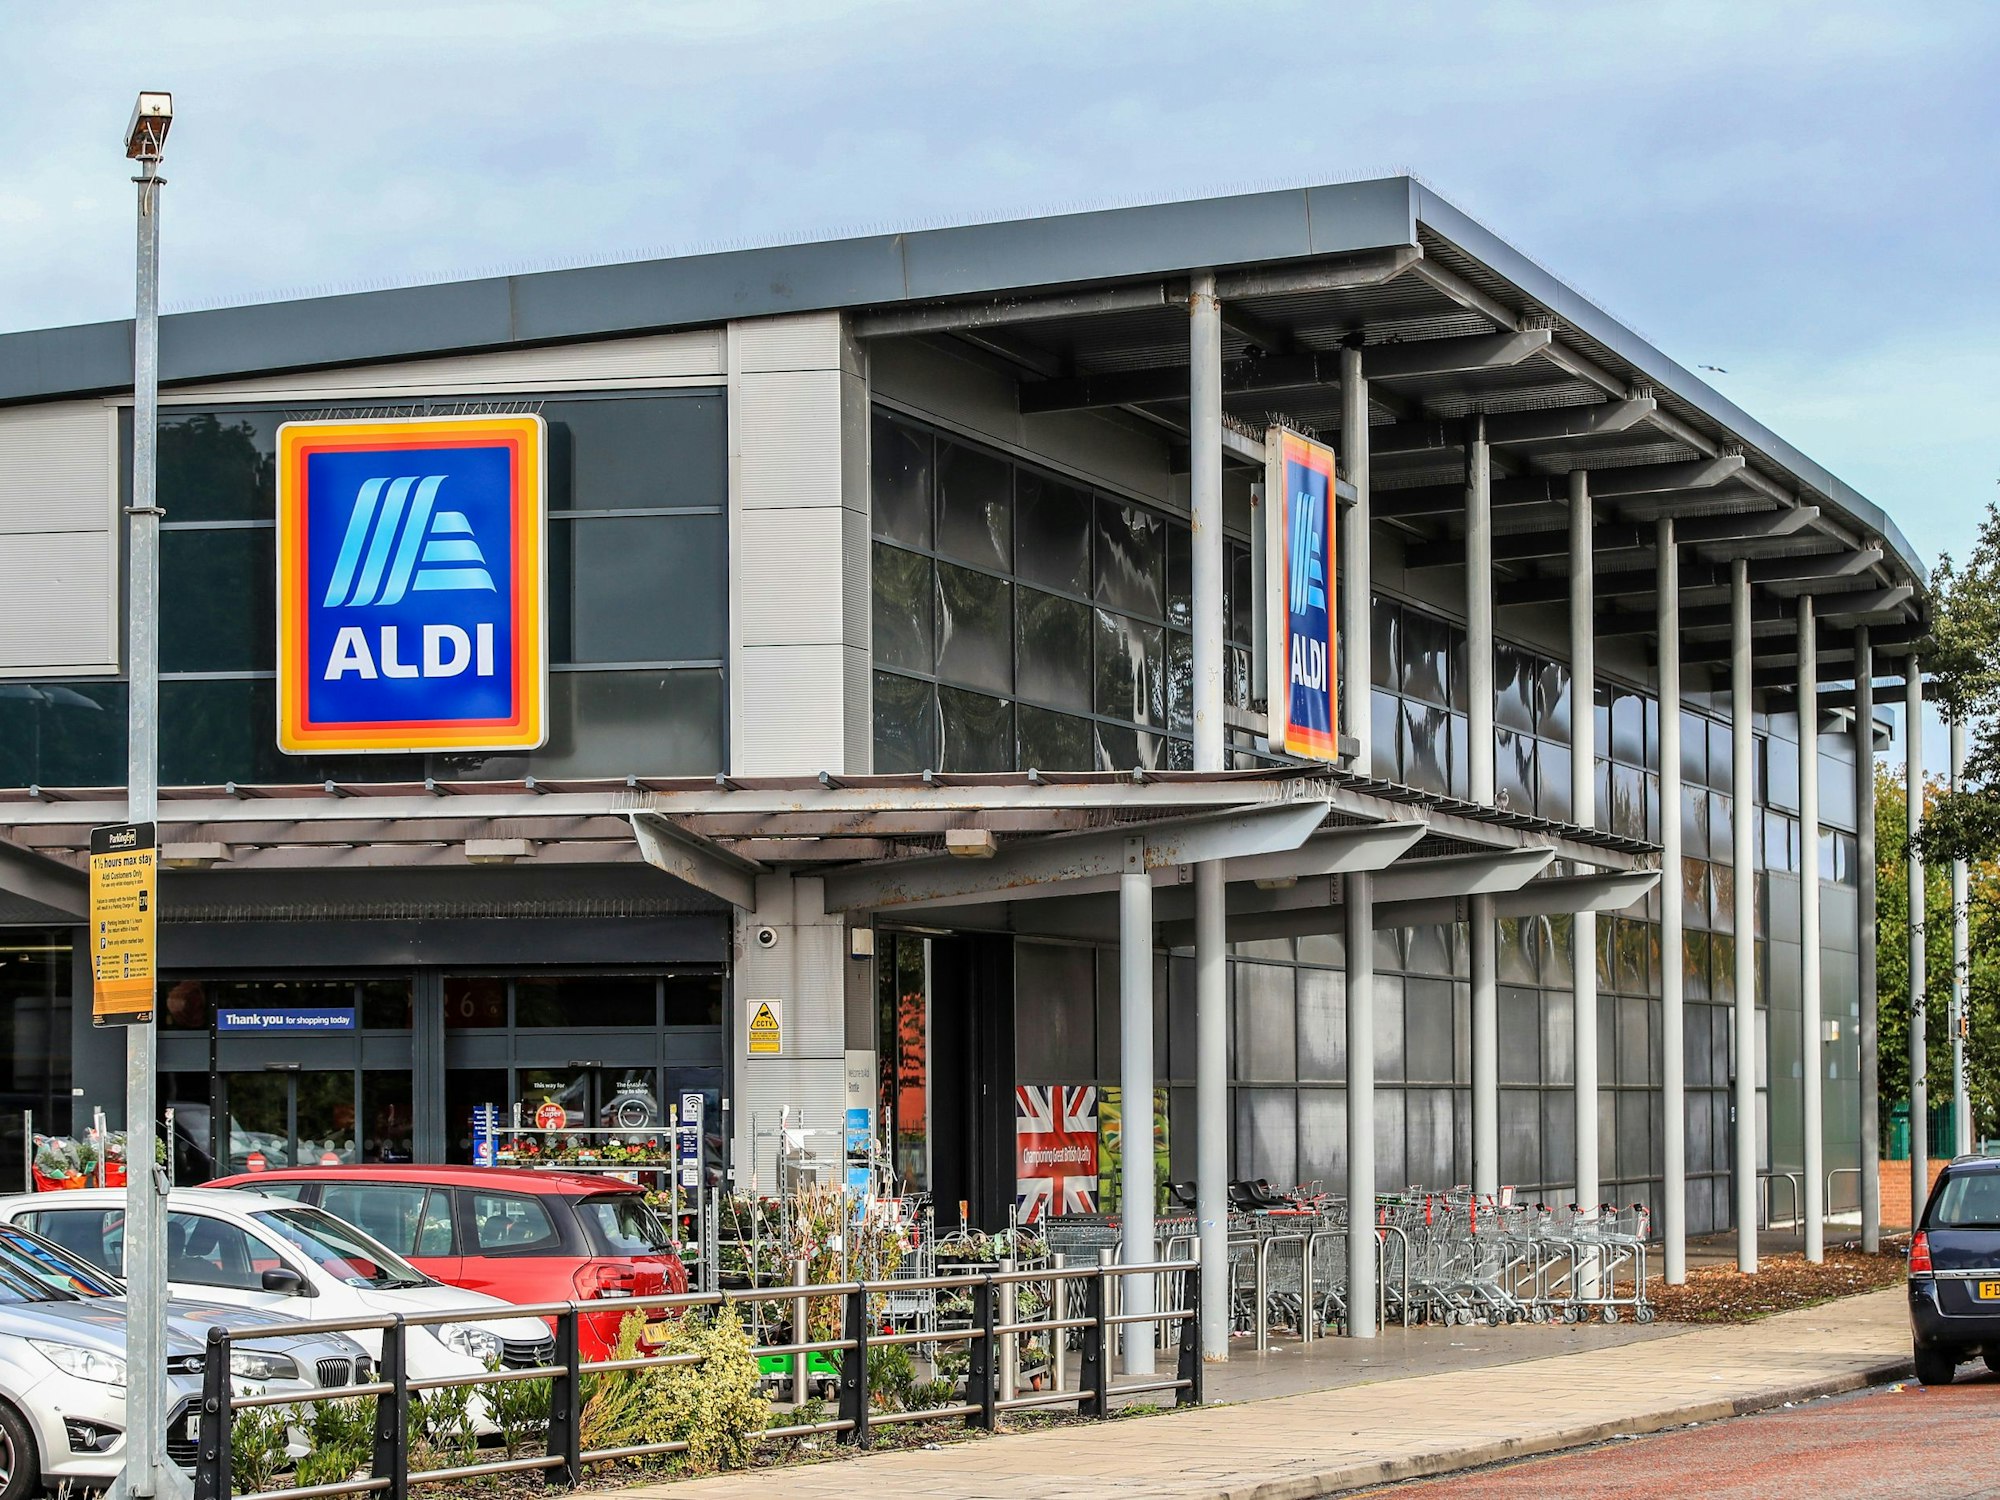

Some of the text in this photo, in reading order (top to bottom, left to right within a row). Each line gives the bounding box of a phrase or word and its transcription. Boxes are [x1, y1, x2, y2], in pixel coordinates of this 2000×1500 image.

[323, 623, 494, 680] ALDI
[1290, 632, 1326, 692] ALDI
[110, 832, 135, 845] ParkingEye
[104, 857, 122, 868] hours
[124, 856, 137, 866] max
[138, 854, 152, 866] stay
[133, 870, 142, 879] Only
[226, 1014, 260, 1025] Thank
[262, 1016, 283, 1026] you
[296, 1016, 329, 1026] shopping
[330, 1016, 350, 1025] today
[546, 1119, 556, 1129] 6
[1024, 1146, 1091, 1167] Championing Great British Quality
